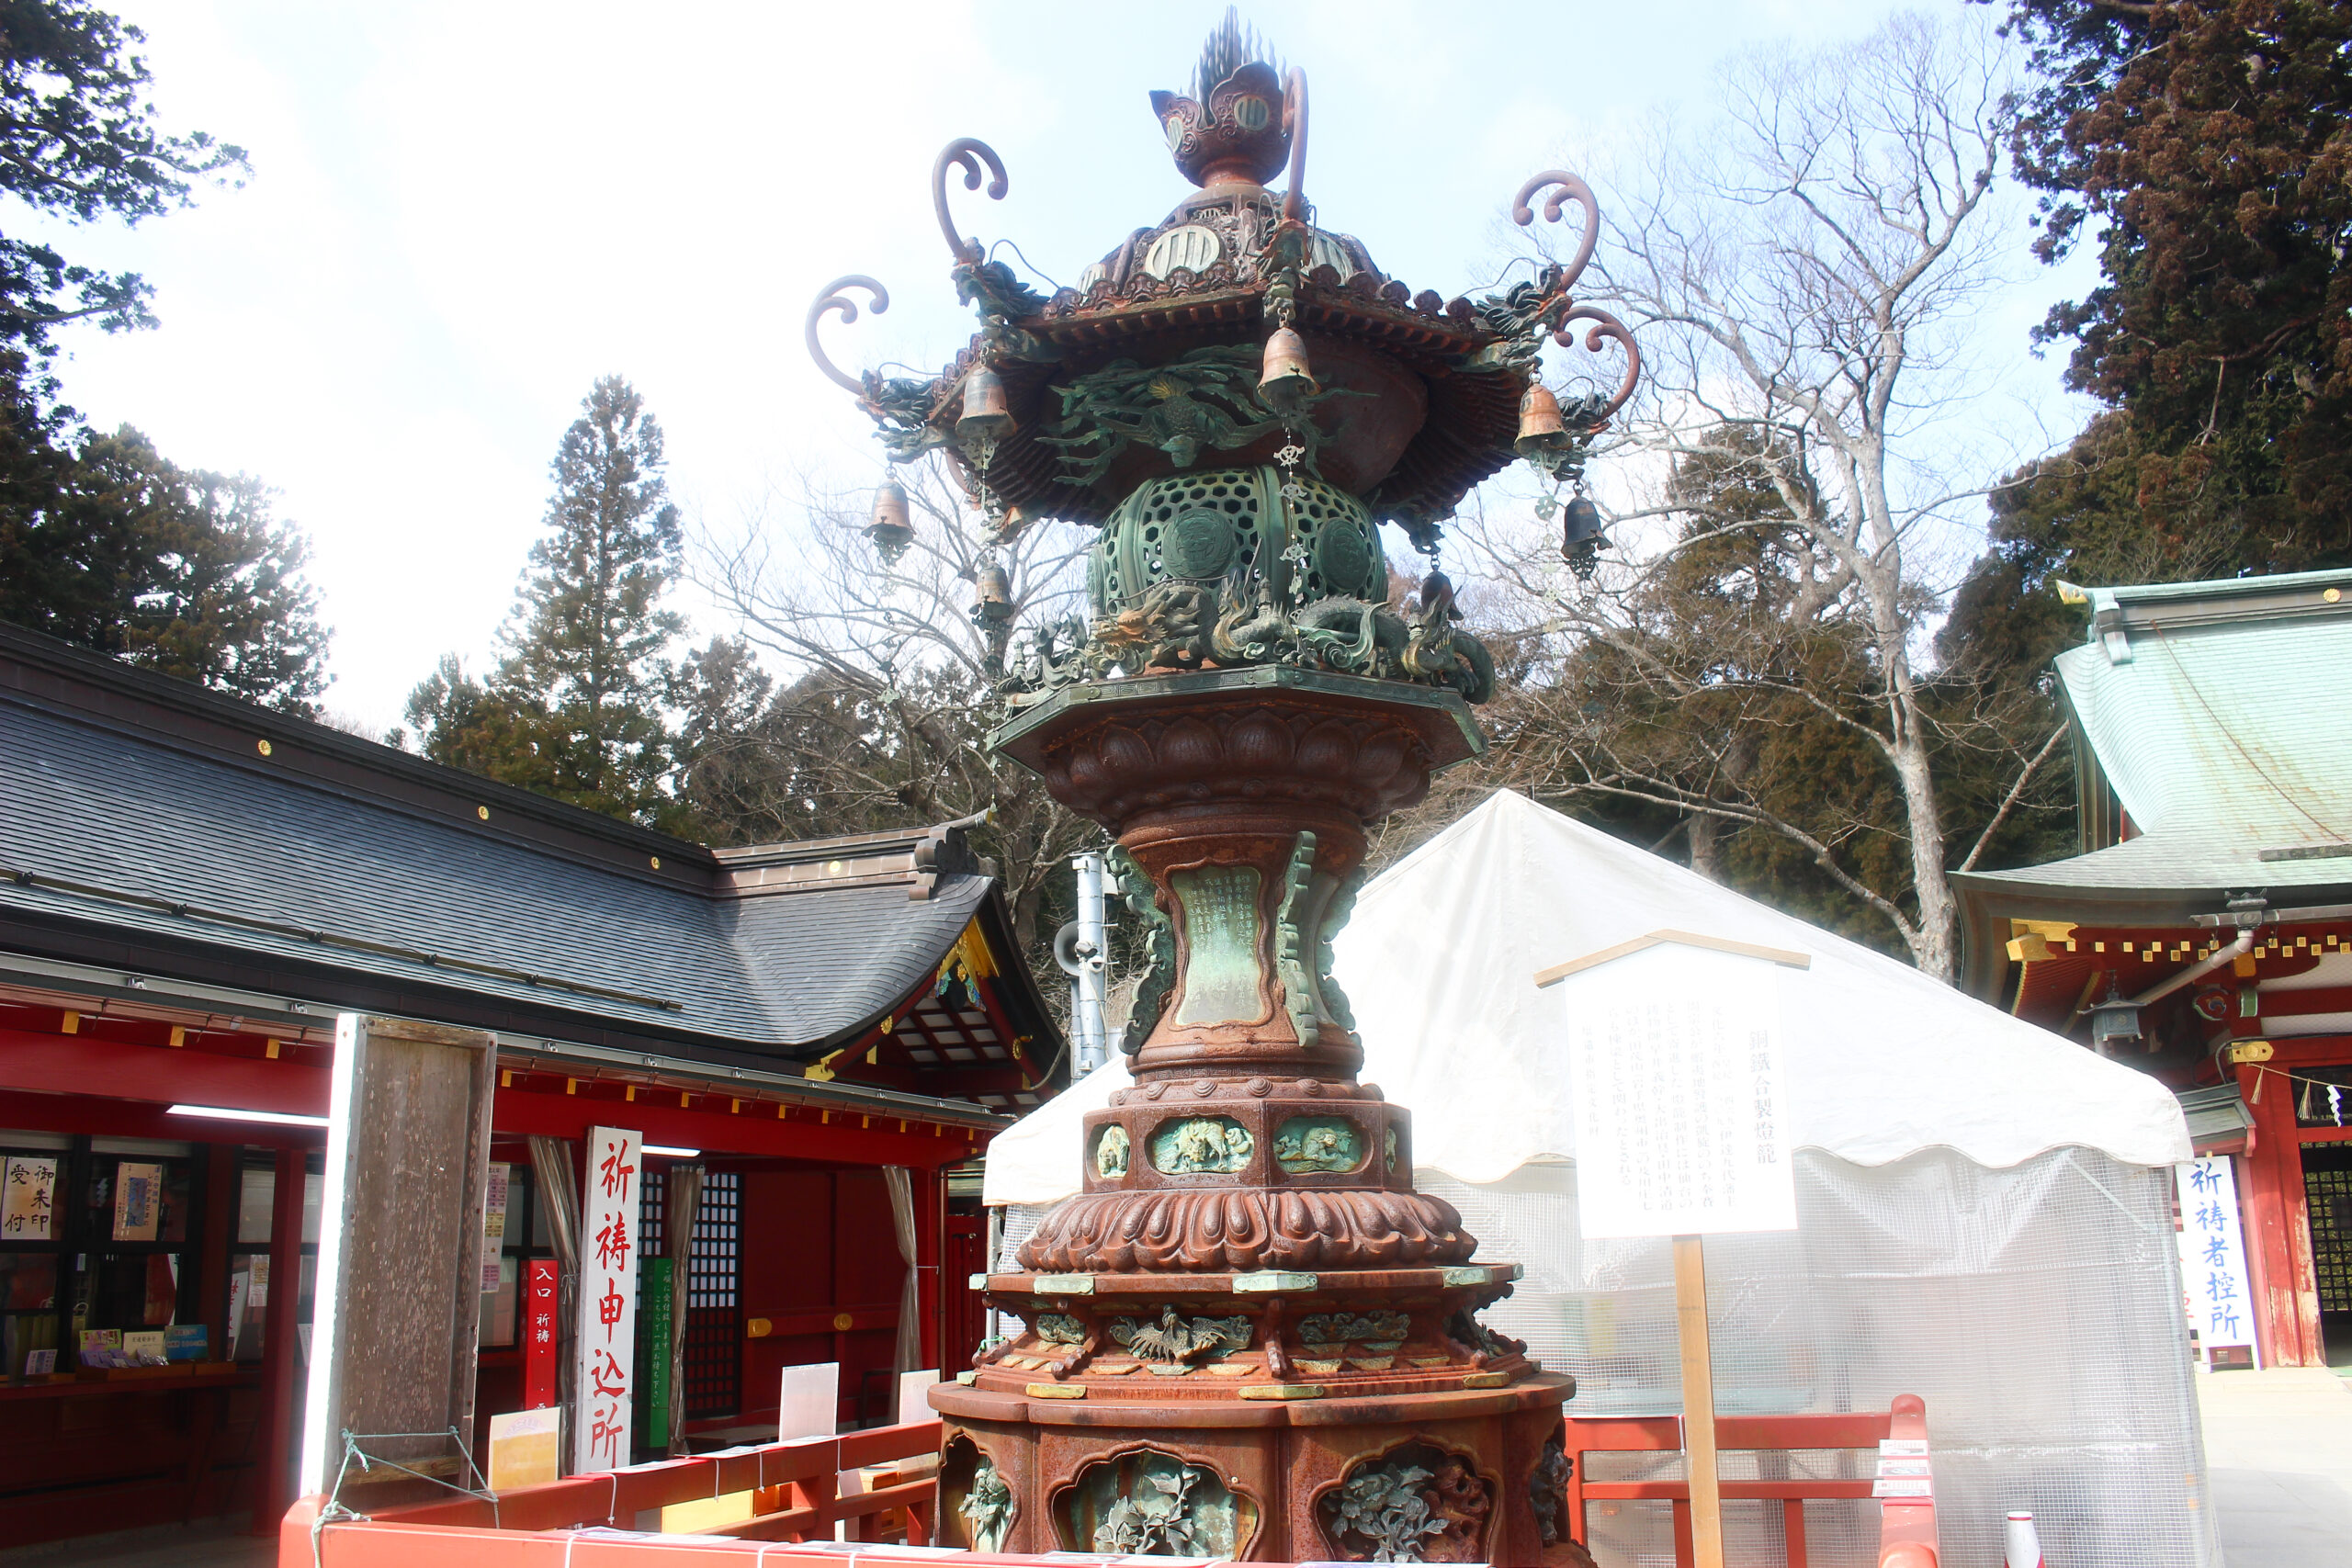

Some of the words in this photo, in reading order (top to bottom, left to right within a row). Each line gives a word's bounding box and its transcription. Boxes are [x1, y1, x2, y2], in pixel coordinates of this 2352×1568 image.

[5, 1163, 30, 1233] 受付
[30, 1165, 54, 1233] 御朱印
[536, 1268, 553, 1298] 入口
[2190, 1161, 2240, 1340] 祈祷者控所
[591, 1138, 634, 1469] 祈祷申込所
